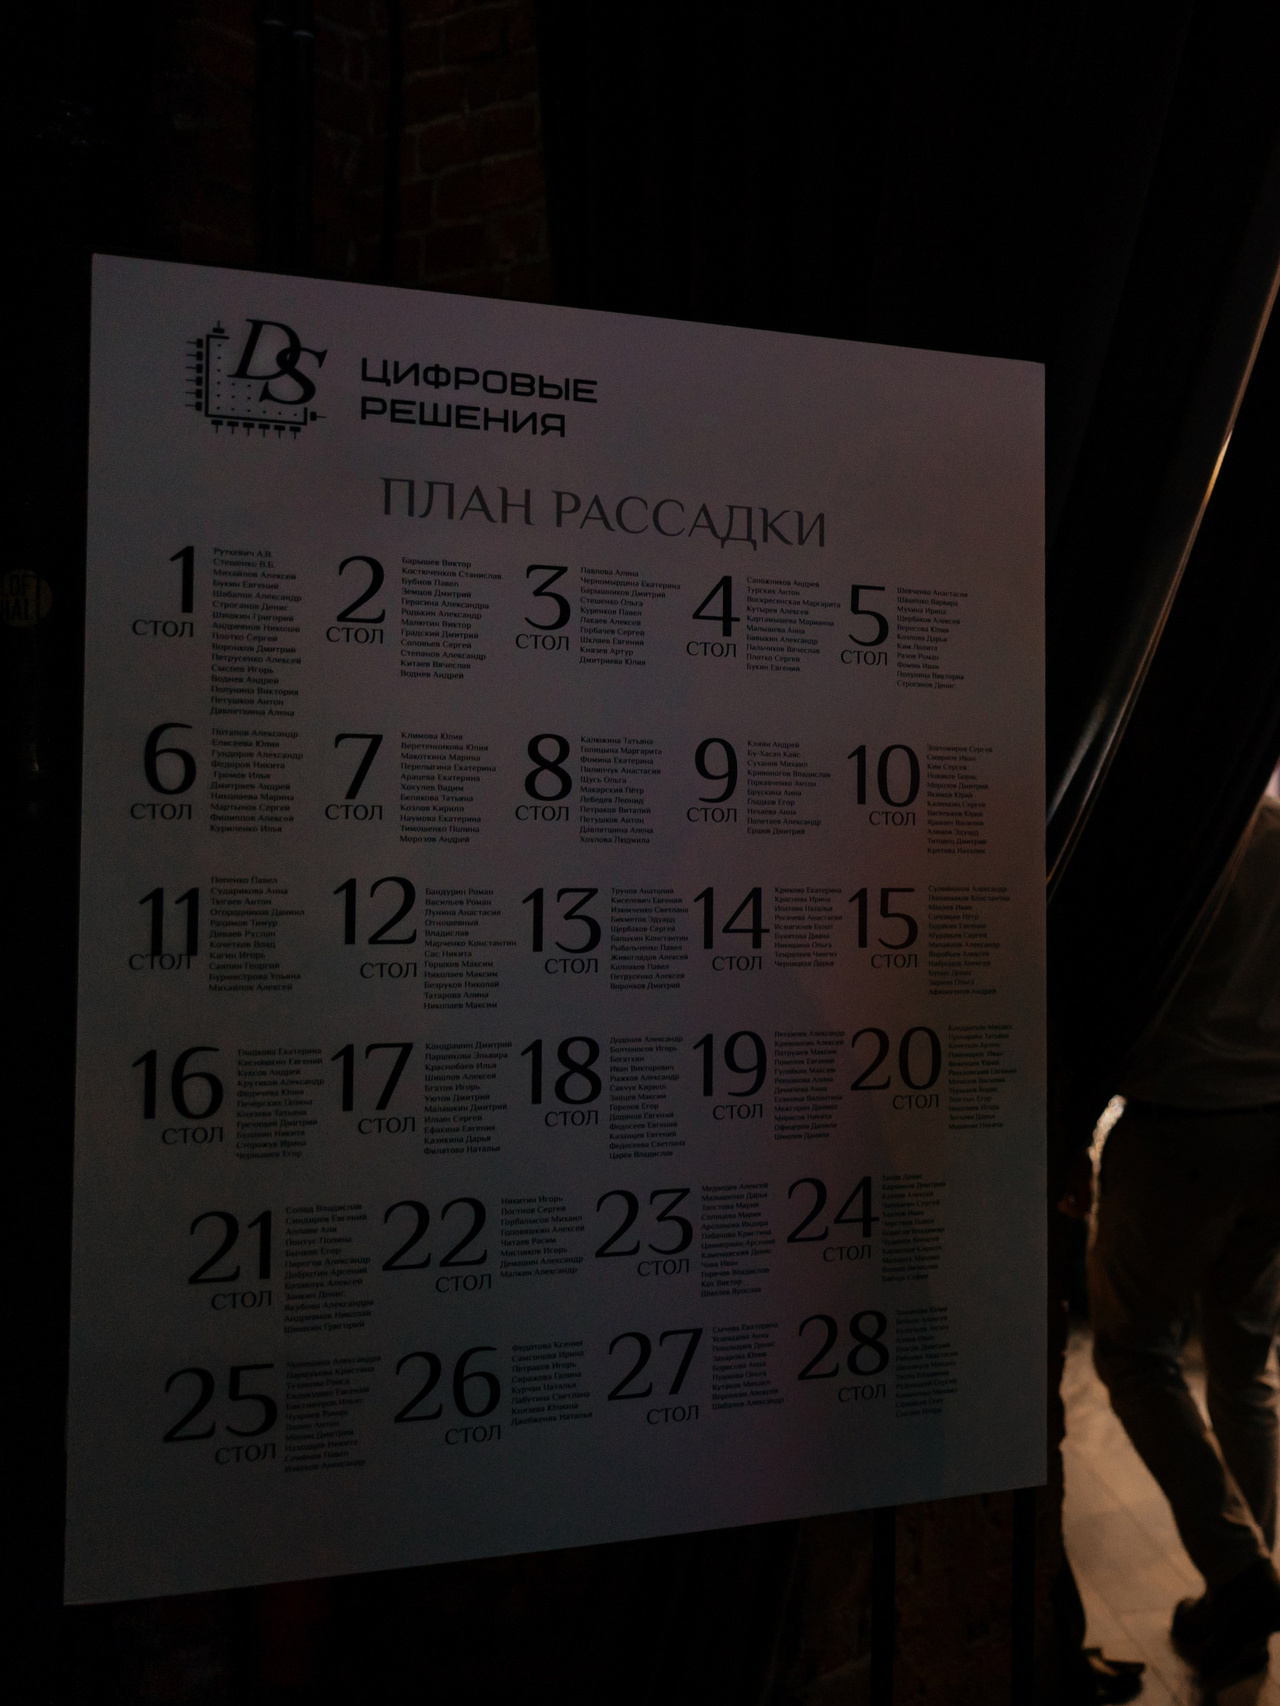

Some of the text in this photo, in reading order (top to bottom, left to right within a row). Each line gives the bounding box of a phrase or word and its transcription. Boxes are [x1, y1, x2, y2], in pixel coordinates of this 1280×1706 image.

[361, 357, 598, 404] ЦИФРОВЫЕ
[360, 396, 565, 438] РЕШЕНИЯ
[380, 477, 825, 551] ПЛАН РАССАДКИ
[402, 557, 471, 570] Барышев Виктор
[581, 566, 639, 578] Павлова Алина
[169, 545, 194, 614] 1
[261, 571, 296, 581] Алексей
[402, 567, 502, 581] Костюченков Станислав
[402, 576, 459, 588] Бубнов Павел
[336, 555, 386, 624] 2
[580, 577, 680, 591] Черномырдина Екатерина
[402, 587, 471, 600] Земцов Дмитрий
[524, 564, 571, 631] 3
[581, 586, 666, 600] Барышников Дмитрий
[441, 600, 489, 611] Александра
[580, 596, 643, 608] Стешенко Ольга
[692, 575, 740, 637] 4
[438, 611, 482, 621] Александр
[580, 606, 642, 617] Куренков Павел
[780, 607, 809, 616] Алексей
[848, 584, 889, 647] 5
[131, 619, 194, 638] СТОЛ
[401, 618, 471, 631] Малютин Виктор
[610, 617, 641, 627] Алексей
[747, 624, 805, 635] Малышева Анна
[326, 626, 384, 644] СТОЛ
[401, 628, 479, 640] Градский Дмитрий
[580, 626, 645, 637] Горбачев Сергей
[400, 638, 472, 650] Соловьев Сергей
[515, 633, 569, 651] СТОЛ
[613, 637, 644, 647] Евгений
[686, 641, 736, 658] СТОЛ
[400, 648, 486, 662] Степанов Александр
[580, 645, 633, 657] Князев Артур
[840, 649, 887, 666] СТОЛ
[400, 659, 471, 670] Китаев Вячеслав
[579, 656, 646, 666] Дмитриева Юлия
[247, 666, 274, 676] Игорь
[400, 669, 464, 681] Воднев Андрей
[211, 696, 284, 706] Петушков Антон
[401, 731, 463, 741] Климова Юлия
[143, 722, 197, 796] 6
[334, 733, 383, 800] 7
[449, 753, 480, 763] Марина
[580, 755, 653, 766] Фомина Екатерина
[524, 733, 572, 802] 8
[694, 737, 738, 803] 9
[847, 744, 920, 808] 10
[211, 791, 294, 803] Николаева Марина
[580, 785, 644, 796] Макарский Пётр
[259, 804, 290, 814] Сергей
[400, 803, 464, 814] Козлов Кирилл
[580, 795, 644, 806] Лебедев Леонид
[129, 803, 192, 820] СТОЛ
[324, 804, 383, 821] СТОЛ
[515, 805, 569, 821] СТОЛ
[619, 806, 651, 815] Виталий
[686, 807, 737, 823] СТОЛ
[869, 811, 916, 826] СТОЛ
[400, 814, 481, 825] Наумова Екатерина
[400, 835, 470, 845] Морозов Андрей
[333, 876, 417, 945] 12
[425, 897, 491, 907] Васильев Роман
[137, 887, 200, 957] 11
[522, 887, 602, 954] 13
[693, 887, 770, 950] 14
[848, 887, 918, 950] 15
[128, 953, 191, 971] СТОЛ
[424, 949, 472, 958] Сас Никита
[871, 953, 918, 969] СТОЛ
[359, 962, 417, 979] СТОЛ
[544, 958, 598, 974] СТОЛ
[711, 956, 762, 972] СТОЛ
[424, 970, 498, 979] Николаев Максим
[425, 1061, 497, 1073] Краснобаев Илья
[693, 1030, 767, 1097] 19
[850, 1026, 942, 1091] 20
[331, 1042, 414, 1112] 17
[425, 1072, 496, 1082] Шишлов Алексей
[521, 1036, 602, 1105] 18
[131, 1046, 224, 1120] 16
[892, 1094, 939, 1110] СТОЛ
[544, 1110, 598, 1127] СТОЛ
[712, 1103, 763, 1120] СТОЛ
[357, 1116, 415, 1135] СТОЛ
[161, 1126, 224, 1145] СТОЛ
[501, 1205, 566, 1216] Постнов Сергей
[786, 1175, 880, 1244] 24
[595, 1187, 693, 1258] 23
[382, 1197, 488, 1272] 22
[187, 1209, 272, 1285] 21
[823, 1244, 871, 1262] СТОЛ
[637, 1258, 690, 1277] СТОЛ
[435, 1273, 492, 1293] СТОЛ
[210, 1290, 272, 1311] СТОЛ
[797, 1310, 890, 1381] 28
[607, 1327, 703, 1401] 27
[394, 1346, 501, 1424] 26
[838, 1383, 886, 1403] СТОЛ
[162, 1363, 278, 1444] 25
[646, 1405, 699, 1425] СТОЛ
[444, 1424, 501, 1445] СТОЛ
[214, 1442, 276, 1465] СТОЛ
